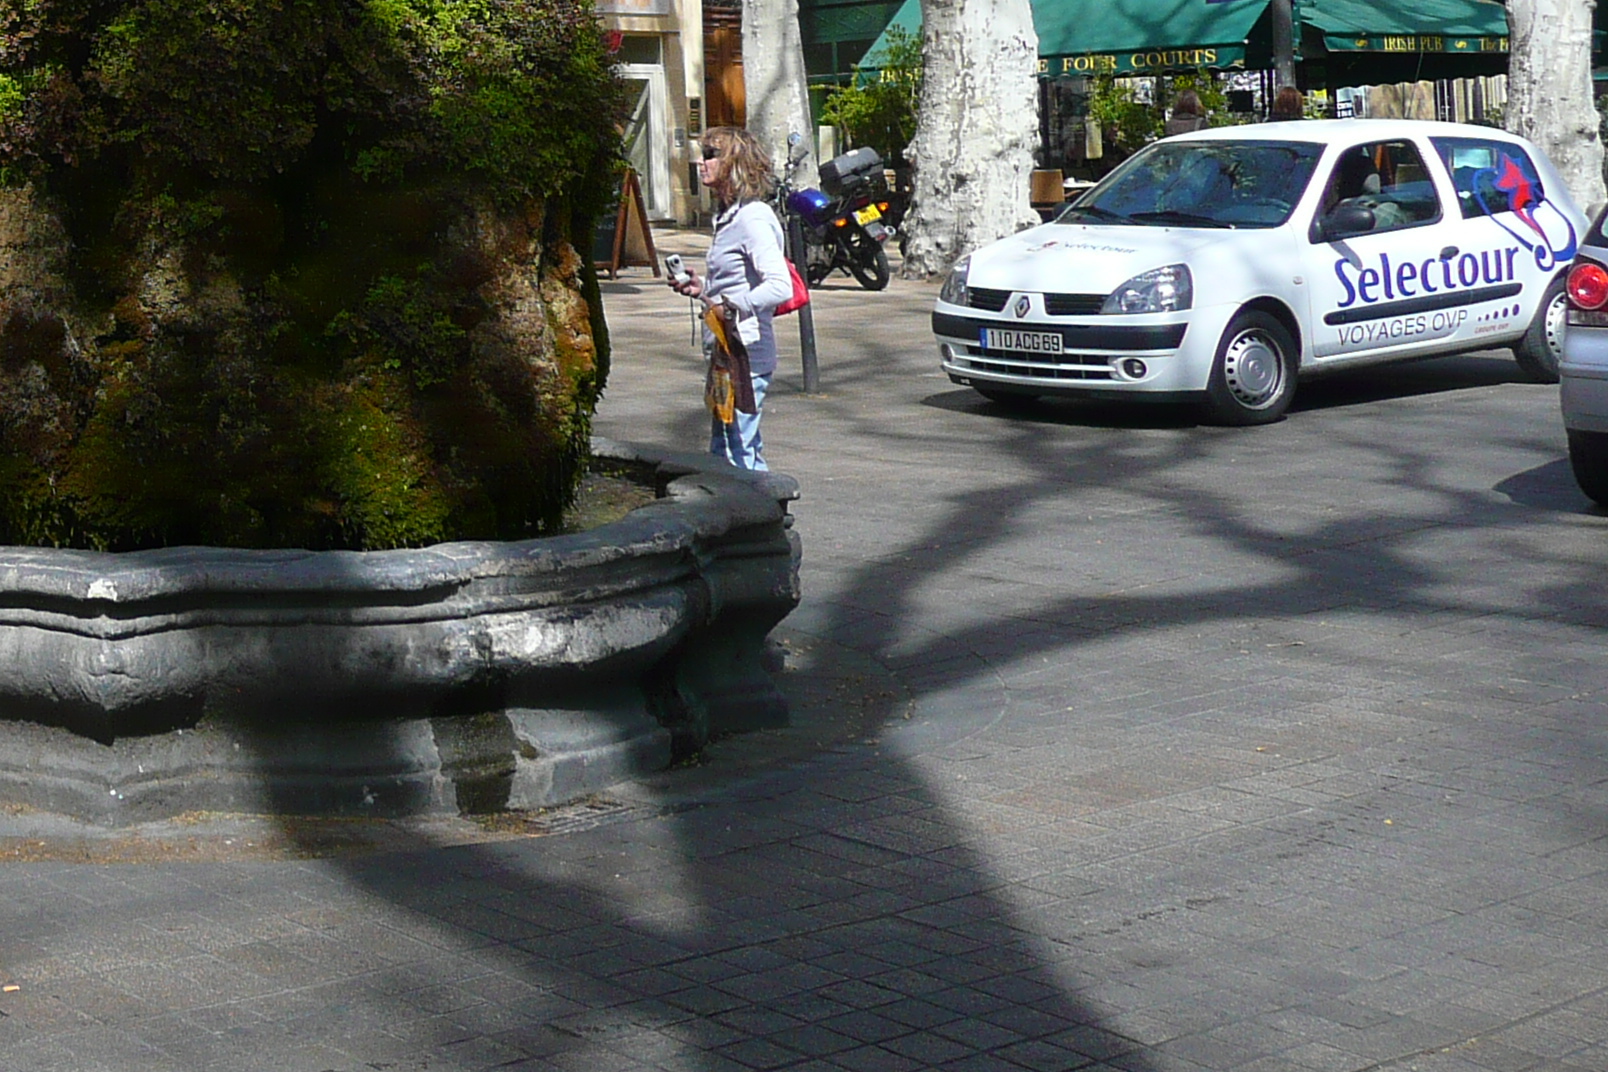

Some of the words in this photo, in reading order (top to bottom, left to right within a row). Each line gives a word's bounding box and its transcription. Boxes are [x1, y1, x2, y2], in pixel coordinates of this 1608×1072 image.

[1384, 36, 1416, 51] IRISH
[1420, 36, 1442, 51] PUB
[1063, 53, 1118, 71] FOUR
[1131, 48, 1217, 68] COURTS
[1334, 246, 1519, 308] Selectour
[1338, 315, 1426, 346] VOYAGES
[1432, 309, 1468, 332] OVP
